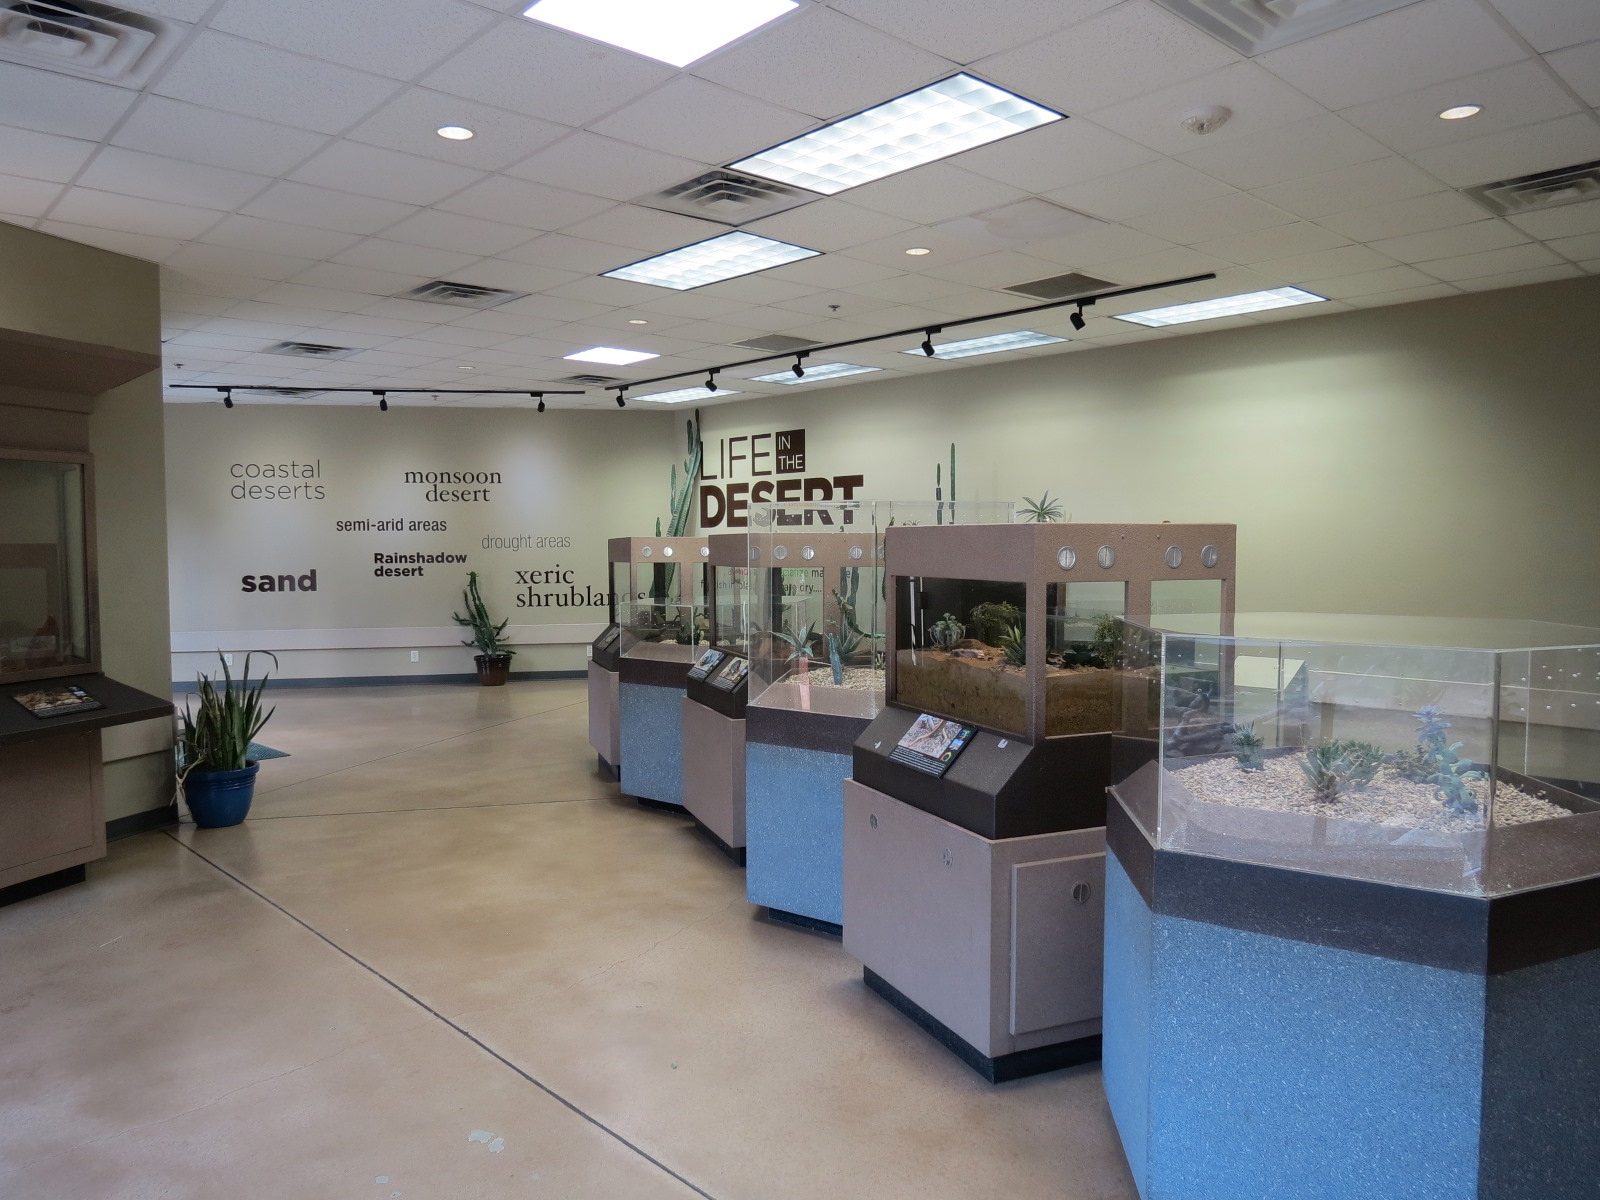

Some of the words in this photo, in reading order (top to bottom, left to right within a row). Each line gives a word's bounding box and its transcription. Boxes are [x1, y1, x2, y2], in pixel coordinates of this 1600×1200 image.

[778, 434, 792, 450] IN
[700, 432, 773, 481] LIFE
[778, 454, 804, 470] THE
[230, 459, 321, 479] coastal
[404, 470, 502, 485] monsoon
[230, 480, 326, 500] deserts
[425, 484, 491, 502] desert
[700, 474, 864, 528] DESERT
[336, 518, 404, 532] semi-arid
[408, 520, 448, 532] areas
[481, 534, 533, 552] drought
[536, 535, 571, 549] areas
[374, 552, 468, 565] Rainshadow
[374, 565, 424, 577] desert
[515, 563, 575, 585] xeric
[241, 568, 318, 593] sand
